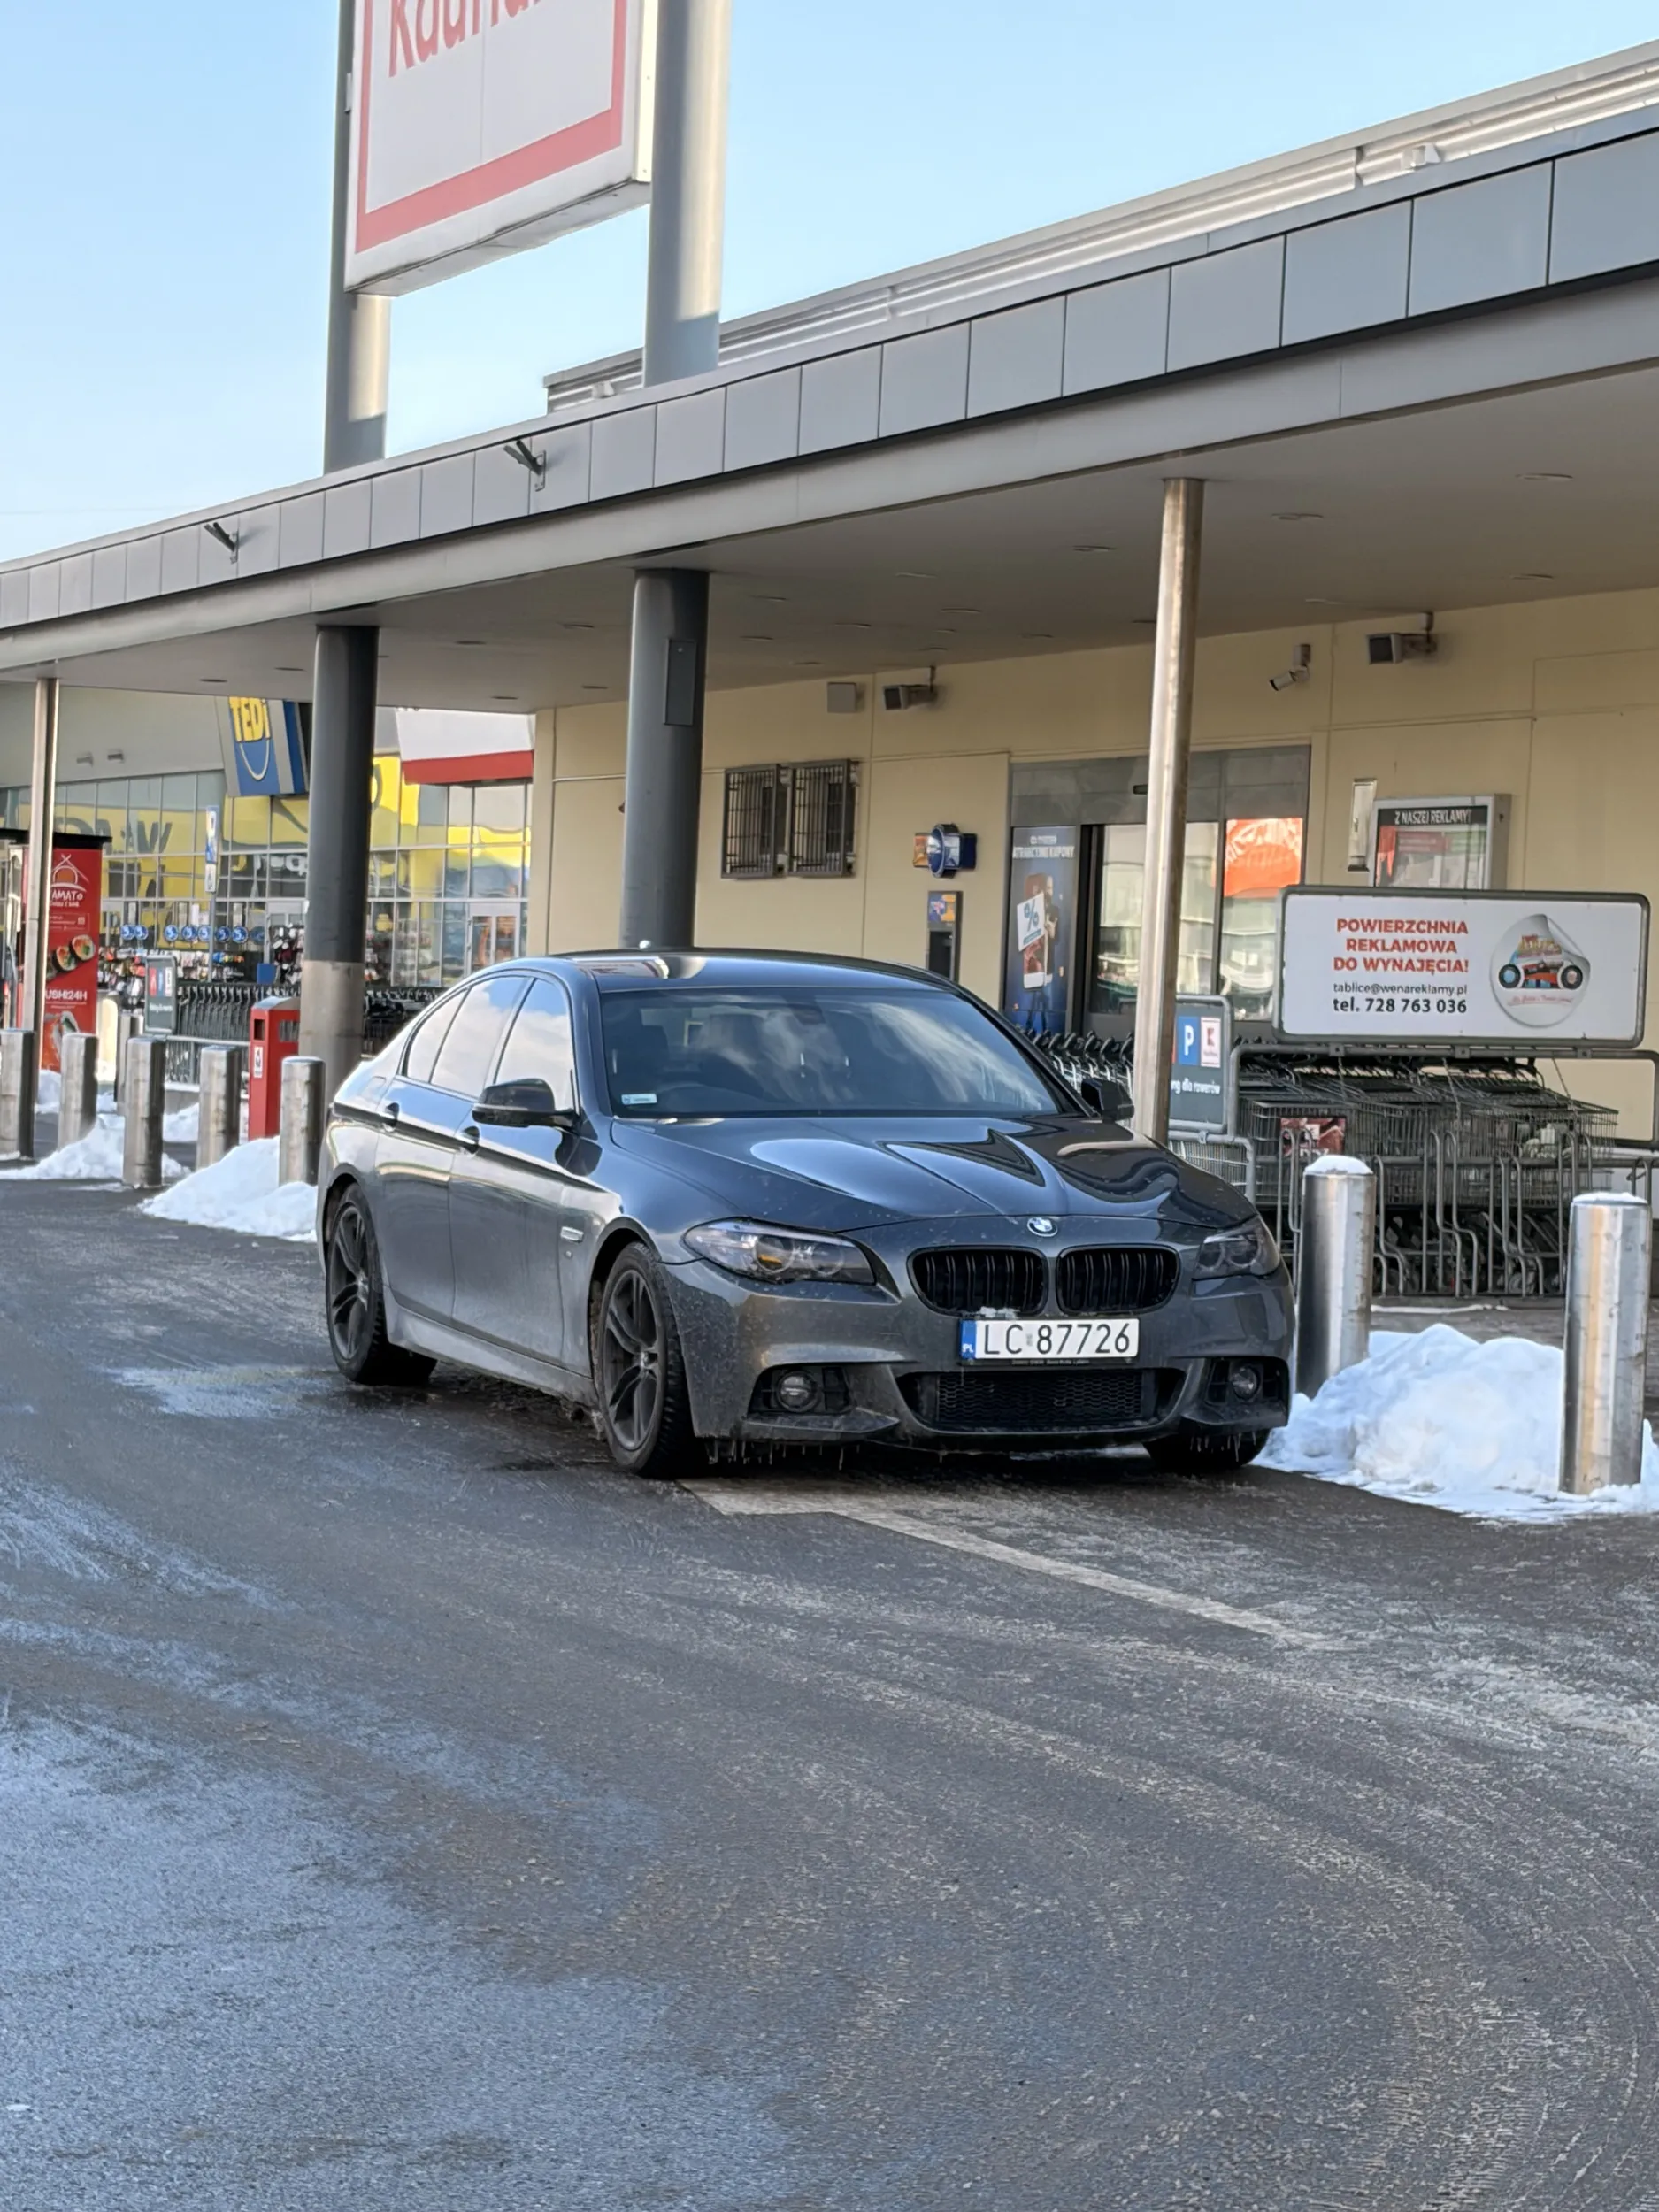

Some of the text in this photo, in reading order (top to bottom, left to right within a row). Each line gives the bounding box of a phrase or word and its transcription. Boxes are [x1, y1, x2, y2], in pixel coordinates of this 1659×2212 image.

[51, 888, 84, 901] AMATO
[1336, 918, 1469, 934] POWIERZCHNIA
[1346, 938, 1458, 954] REKLAMOWA
[1333, 956, 1469, 976] DO WYNAJĘCIA!
[45, 988, 88, 1001] USHI24H
[1333, 982, 1468, 997] tablice@wenareklamy.pl
[1333, 996, 1467, 1014] tel. 728 763 036
[1184, 1025, 1194, 1056] P
[984, 1323, 1024, 1355] LC
[1036, 1323, 1130, 1355] 87726
